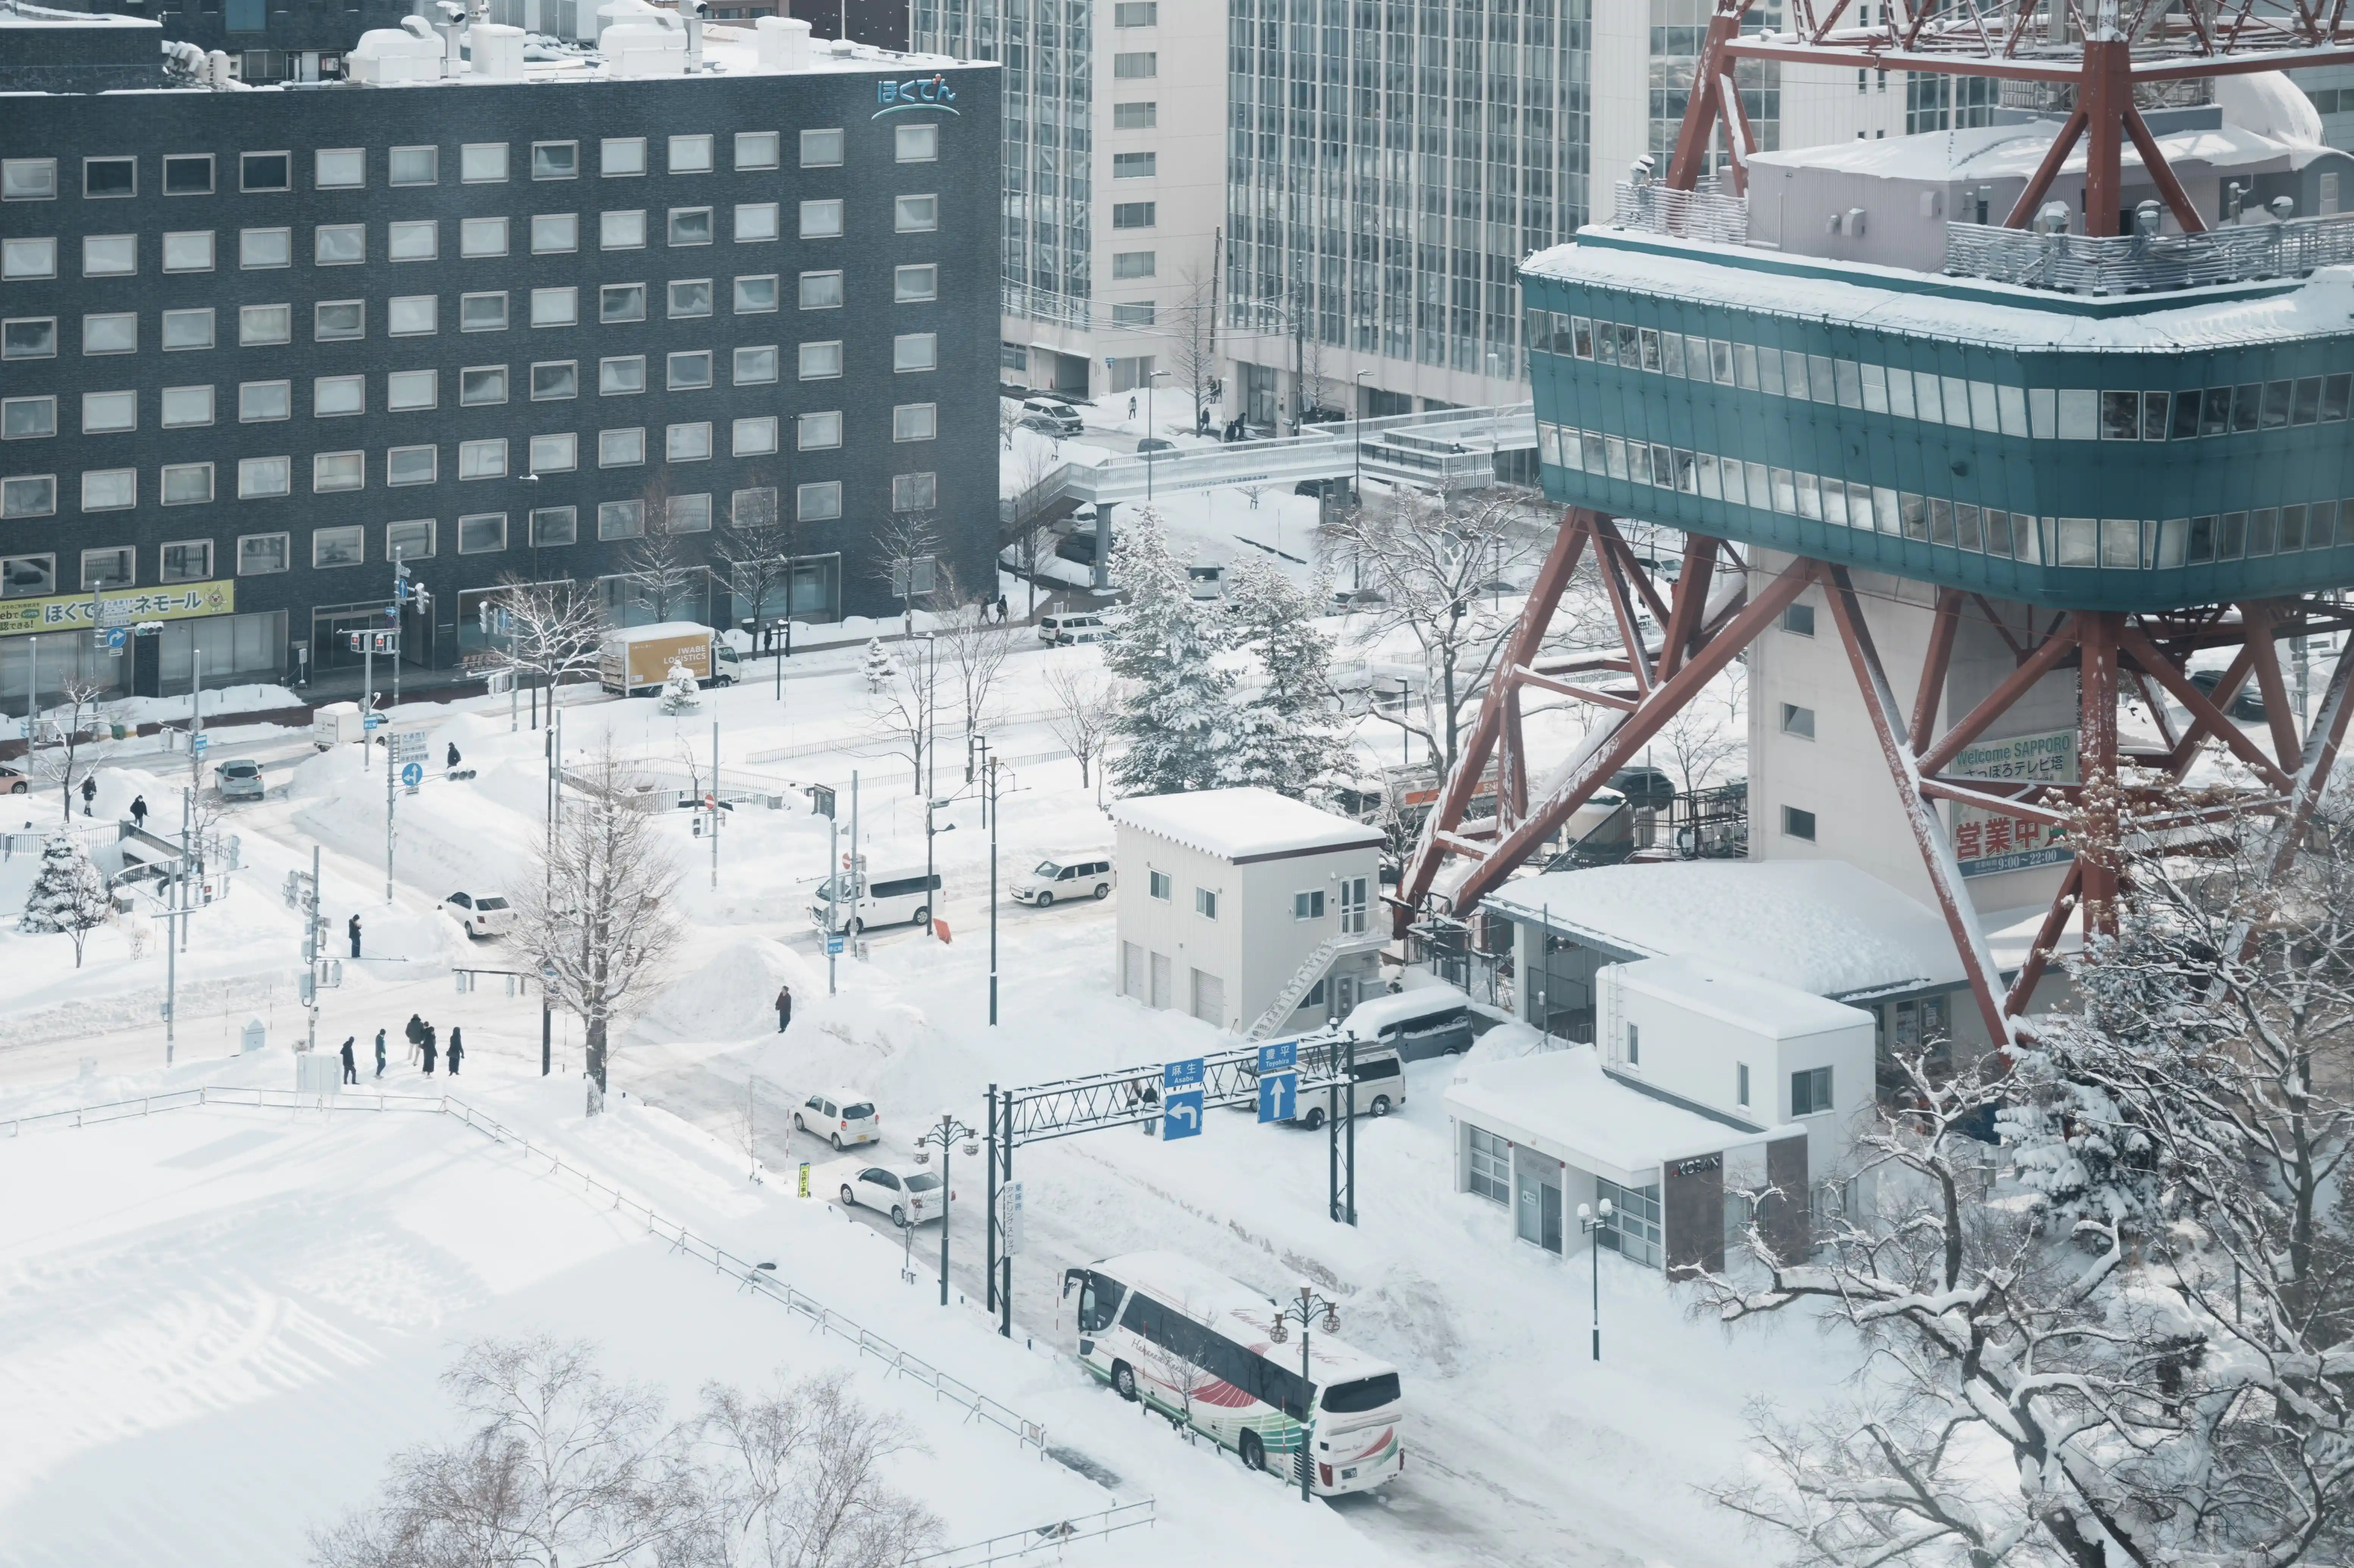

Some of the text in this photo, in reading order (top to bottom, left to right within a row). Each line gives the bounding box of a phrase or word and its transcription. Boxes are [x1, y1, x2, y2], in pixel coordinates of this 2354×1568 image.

[878, 73, 956, 103] ほくでん
[678, 645, 706, 655] IWABE
[664, 653, 706, 664] LOGISTICS
[1957, 735, 2071, 767] Welcome SAPPORO
[1956, 816, 2040, 861] 営業中
[1266, 1046, 1290, 1060] 豊平
[1266, 1058, 1290, 1067] Toyohira
[1171, 1063, 1197, 1077] 麻生
[1174, 1076, 1194, 1084] Asabu
[1678, 1156, 1719, 1177] KOBAN
